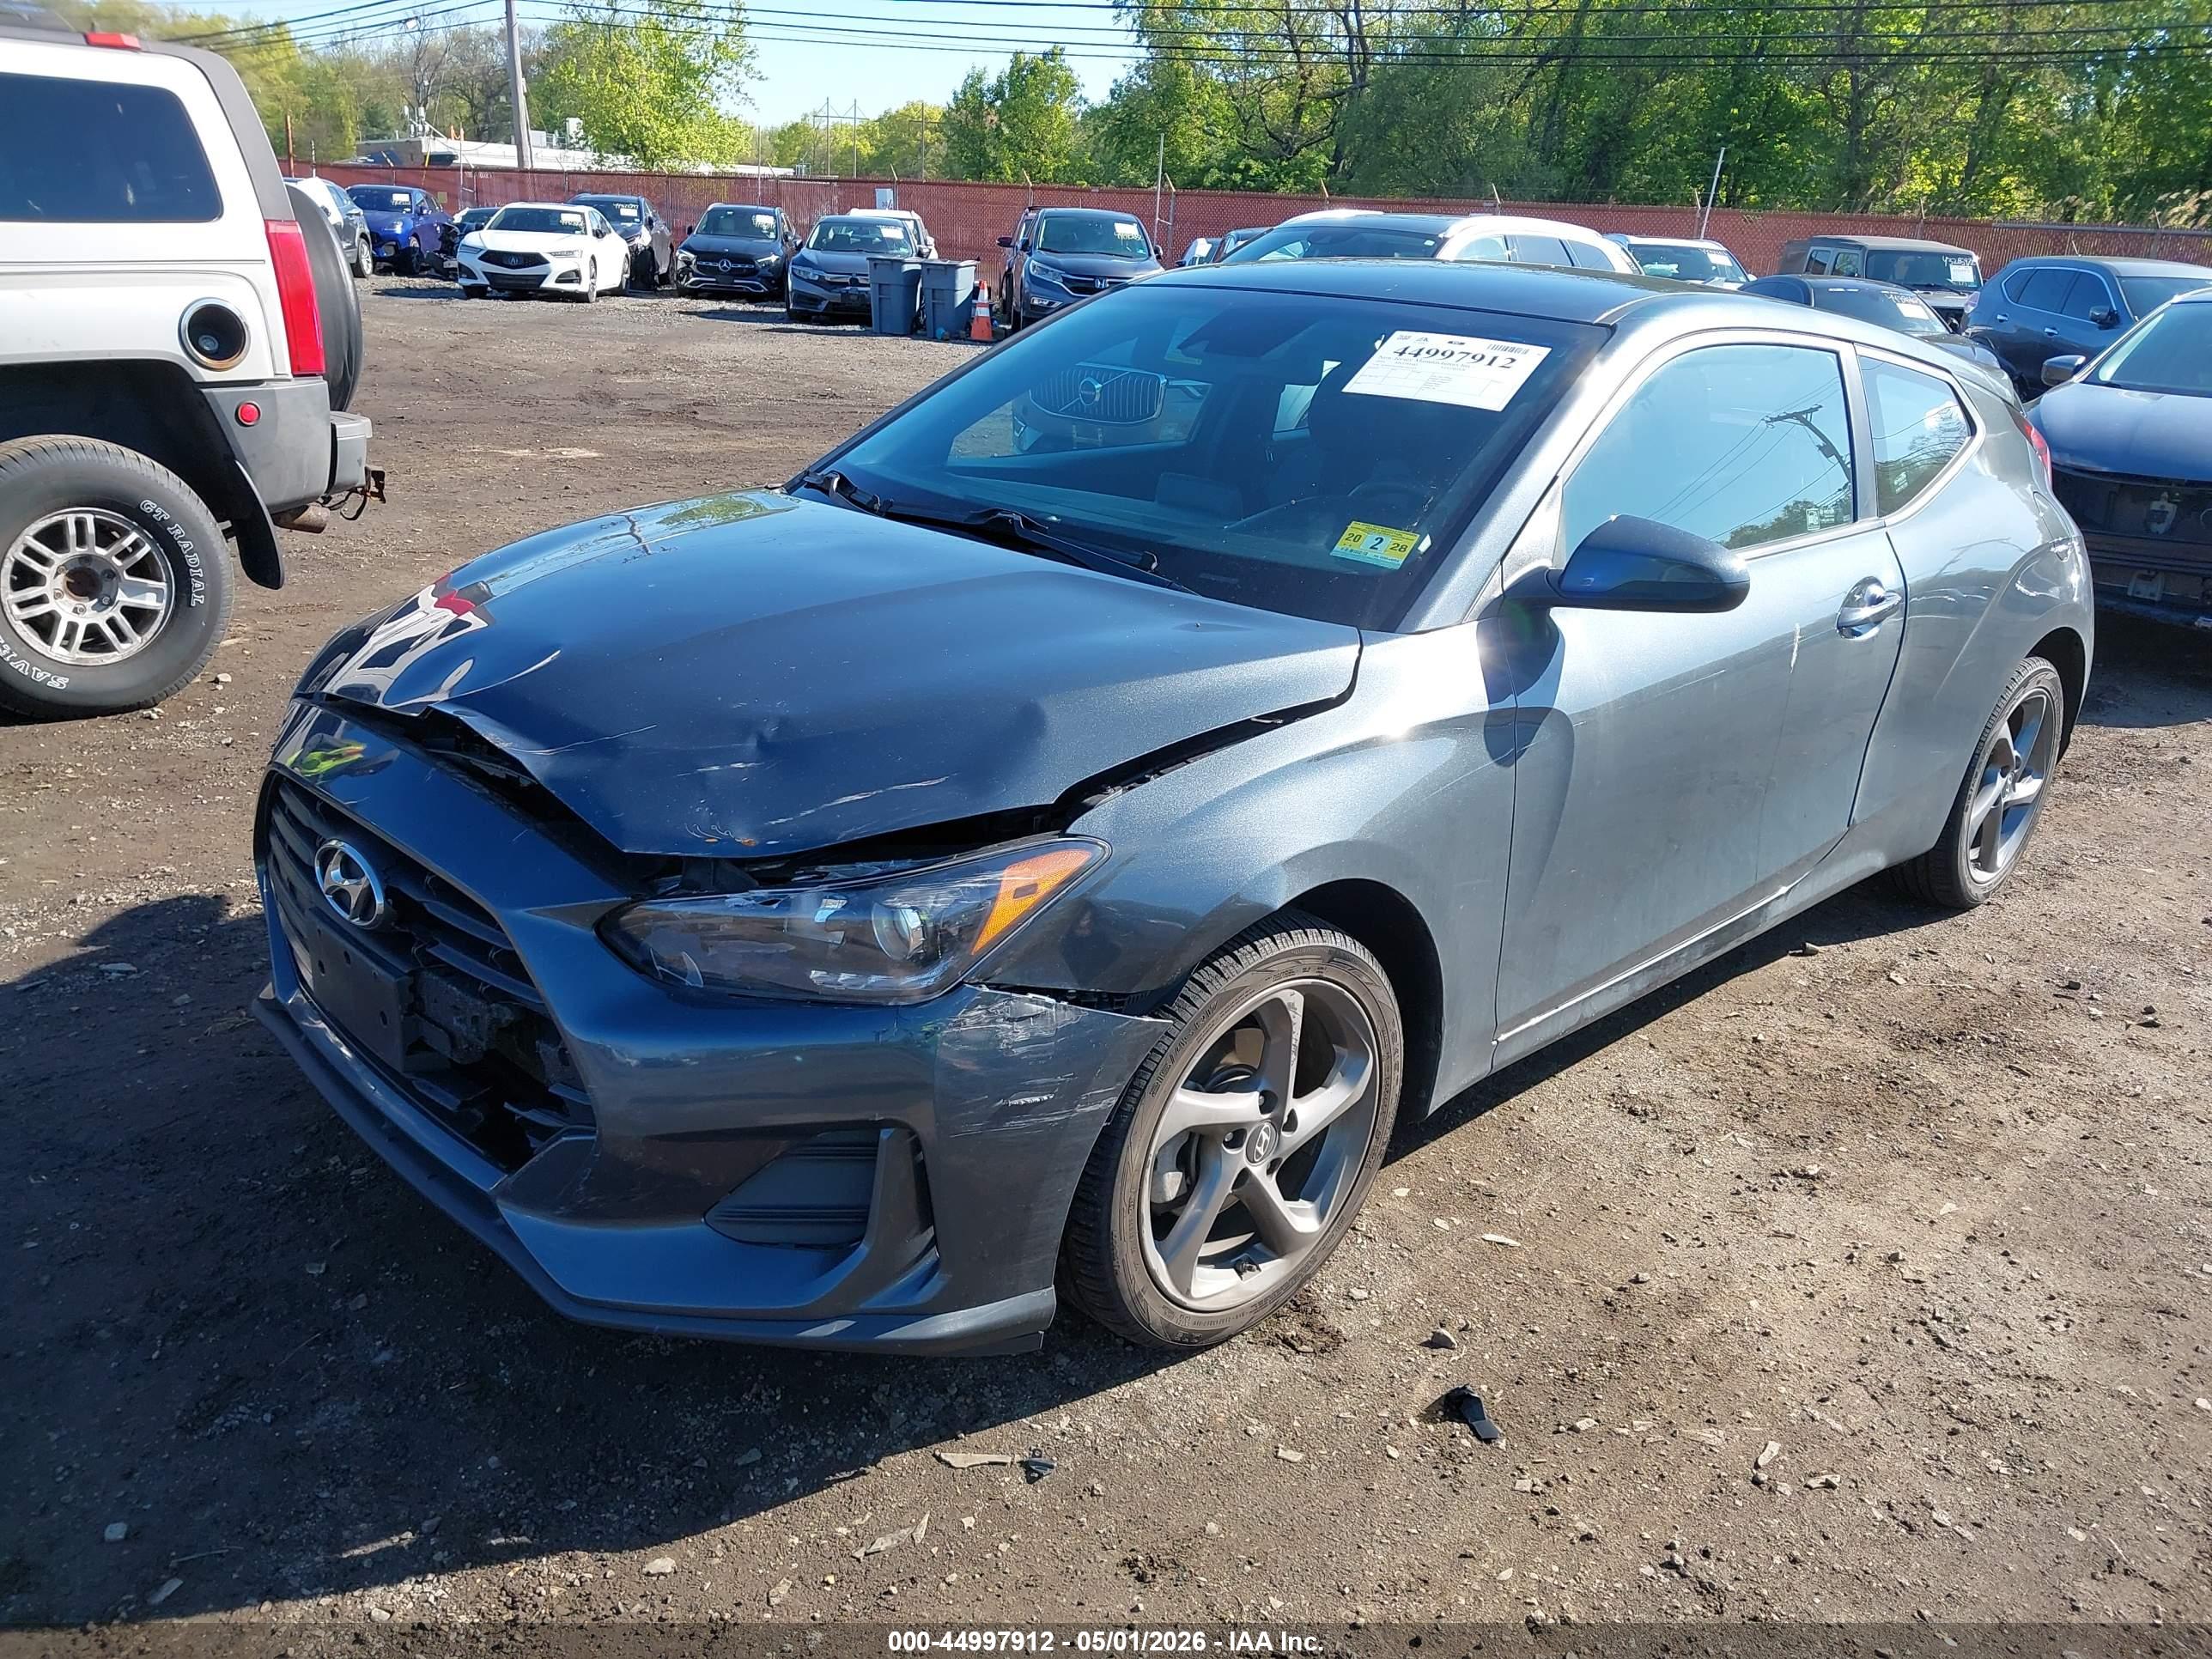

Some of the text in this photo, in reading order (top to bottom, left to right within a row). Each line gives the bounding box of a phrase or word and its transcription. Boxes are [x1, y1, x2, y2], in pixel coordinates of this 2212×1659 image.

[1393, 345, 1517, 368] 44997912
[139, 499, 205, 607] GT RADIAL
[1346, 532, 1408, 553] 20 2 28
[0, 635, 70, 690] SAVE
